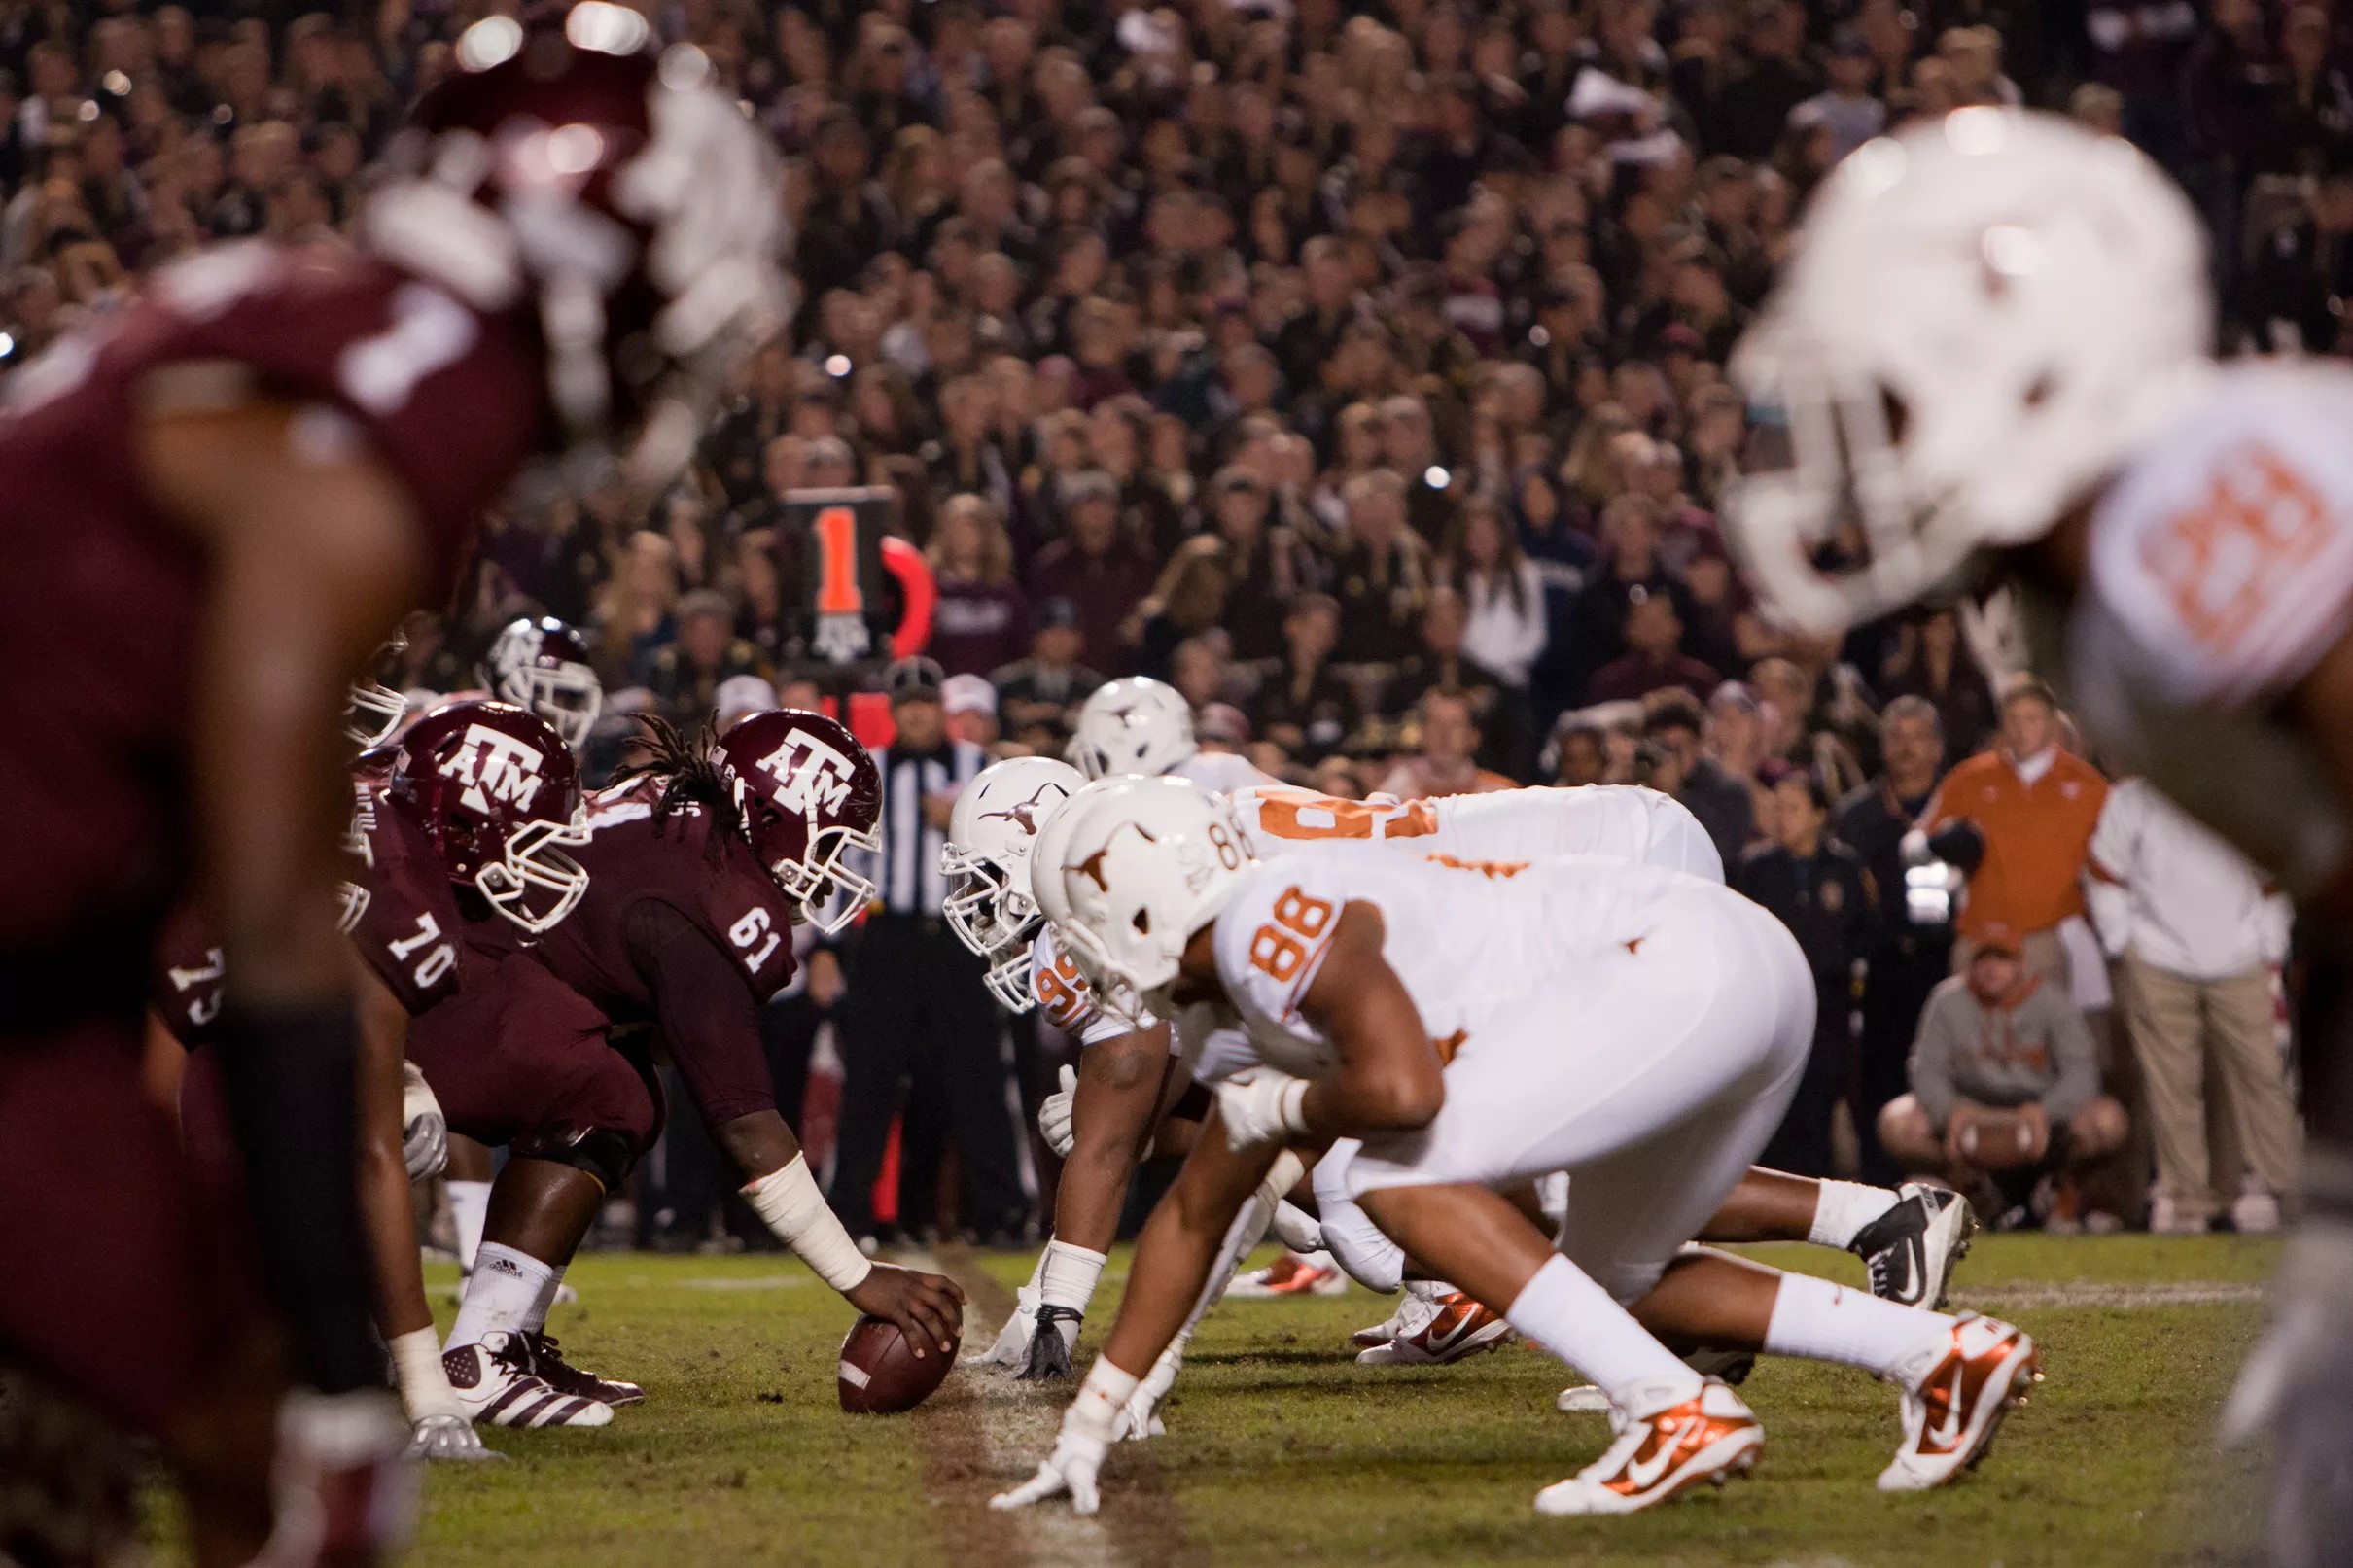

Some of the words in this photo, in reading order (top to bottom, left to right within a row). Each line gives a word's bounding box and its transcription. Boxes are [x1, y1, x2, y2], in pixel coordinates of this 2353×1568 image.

[813, 506, 864, 614] 1
[388, 911, 456, 989] 70
[729, 907, 781, 975] 61
[1249, 886, 1333, 983] 88
